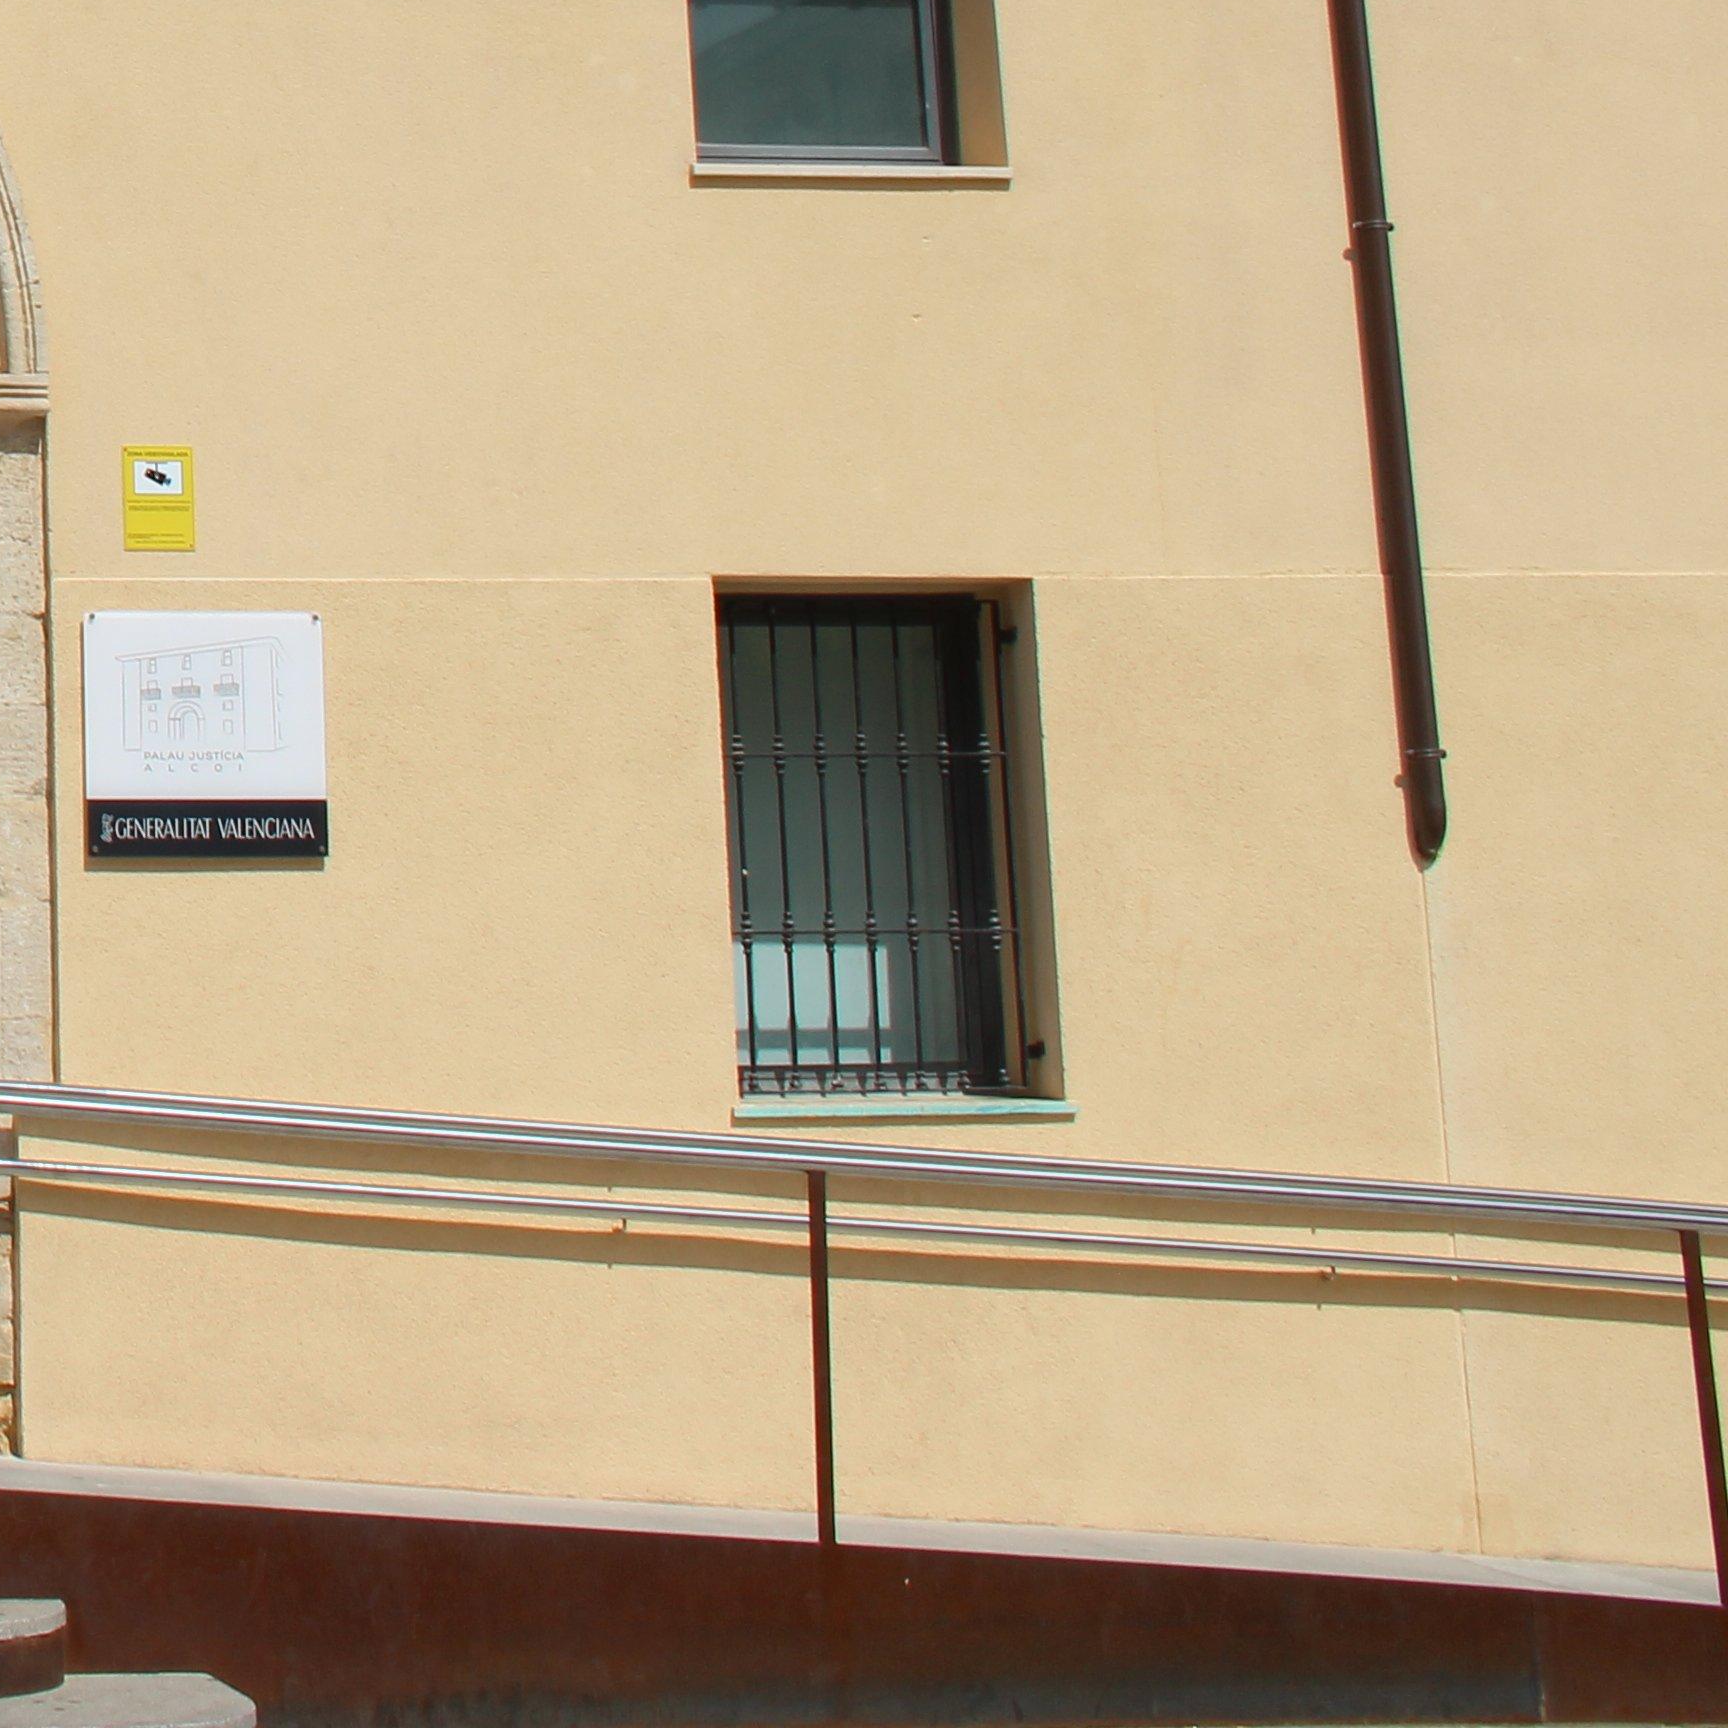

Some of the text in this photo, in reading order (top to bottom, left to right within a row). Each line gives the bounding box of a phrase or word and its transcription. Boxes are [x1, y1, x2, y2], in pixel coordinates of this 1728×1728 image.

[144, 750, 244, 761] PALAU JUSTÍCIA
[115, 817, 315, 839] GENERALITAT VALENCIANA
